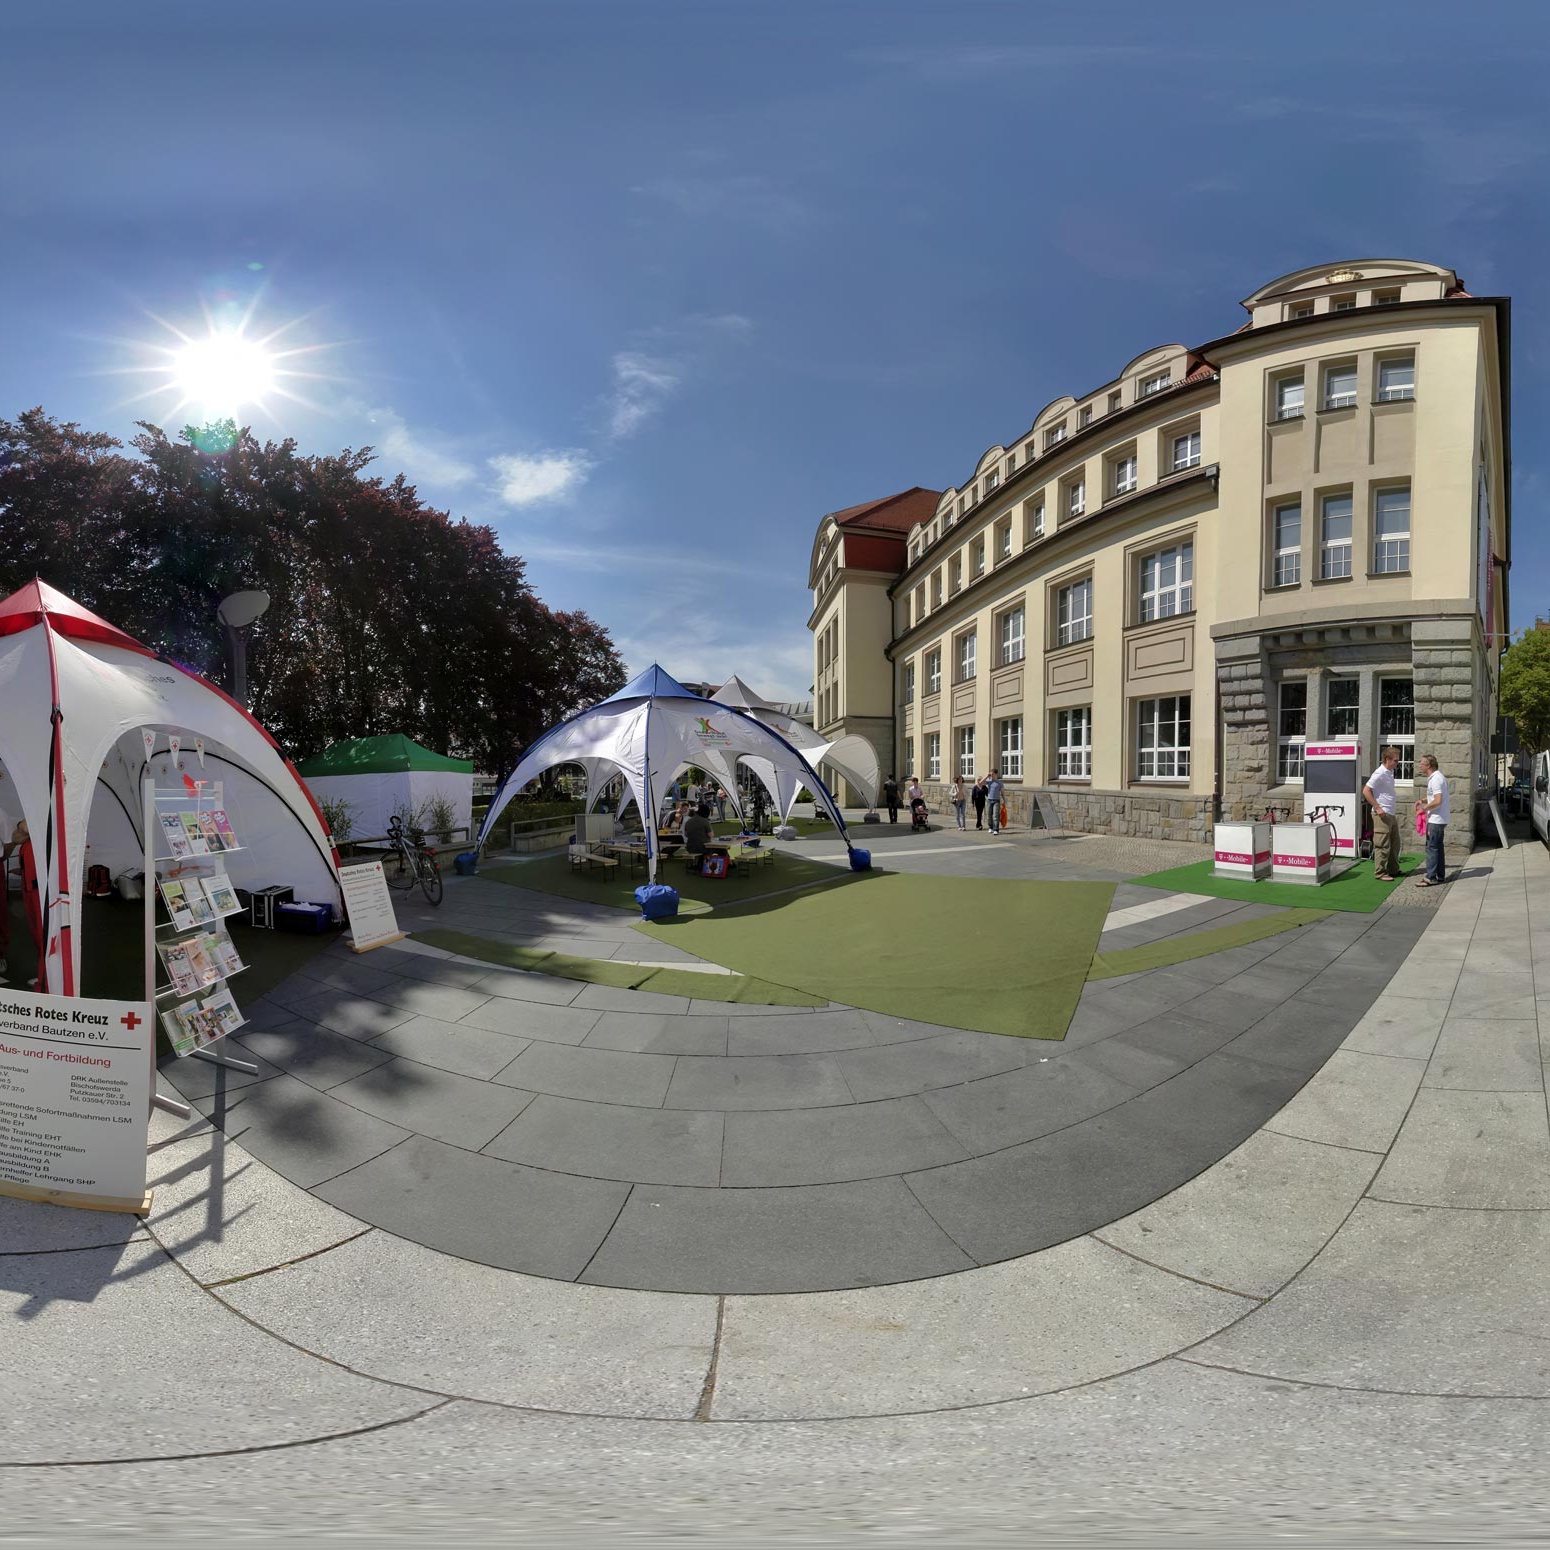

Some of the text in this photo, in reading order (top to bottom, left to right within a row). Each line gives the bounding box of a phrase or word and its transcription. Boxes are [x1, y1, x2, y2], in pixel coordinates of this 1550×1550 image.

[35, 1006, 68, 1022] Rotes
[72, 1010, 109, 1026] Kreuz
[42, 1025, 86, 1039] Bautzen
[88, 1032, 109, 1041] e.V.
[23, 1048, 43, 1059] und
[46, 1051, 111, 1068] Fortbildung
[70, 1082, 121, 1093] Bischofswerda
[88, 1077, 129, 1086] Außenstelle
[70, 1088, 105, 1097] Putzkauer
[82, 1097, 131, 1106] 03594/703134
[19, 1113, 37, 1121] LSM
[36, 1106, 111, 1122] Sofortmaßnahmen
[112, 1115, 132, 1124] LSM
[12, 1127, 43, 1140] Training
[44, 1134, 62, 1142] EHT
[10, 1135, 23, 1143] bei
[24, 1138, 86, 1153] Kindernotfällen
[23, 1146, 42, 1156] Kind
[43, 1150, 62, 1158] EHK
[4, 1173, 30, 1184] Pflege
[34, 1171, 74, 1184] Lehrgang
